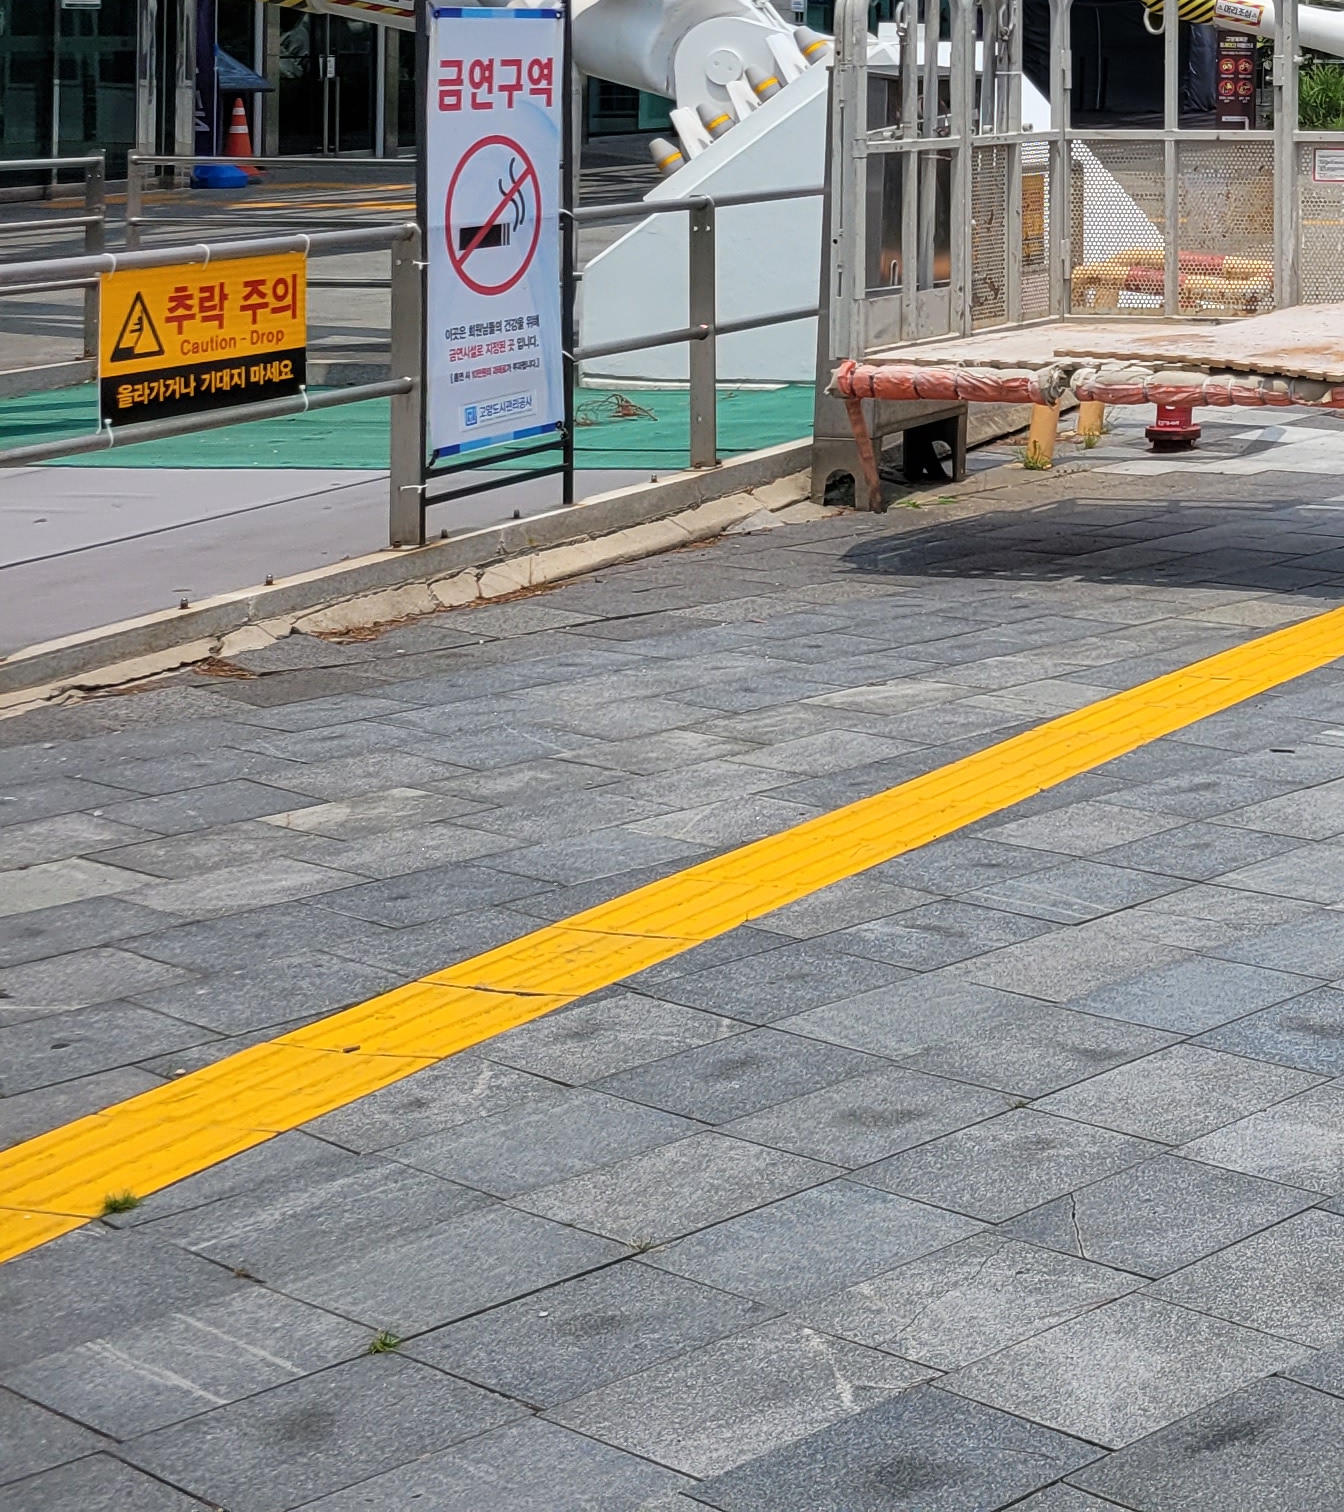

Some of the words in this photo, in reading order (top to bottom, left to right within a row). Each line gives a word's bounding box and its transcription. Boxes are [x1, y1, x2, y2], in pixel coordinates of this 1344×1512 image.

[1223, 4, 1252, 19] 머리조심
[437, 56, 555, 113] 금연구역
[164, 281, 229, 335] 추락
[239, 273, 298, 325] 주의
[445, 325, 467, 342] 이곳은
[504, 316, 525, 333] 건강을
[180, 335, 237, 356] Caution
[250, 329, 285, 347] Drop
[448, 344, 485, 363] 금연시설로
[486, 339, 506, 355] 지정된
[116, 373, 197, 409] 올라가거나
[200, 365, 246, 393] 기대지
[250, 359, 295, 386] 마세요
[479, 395, 533, 419] 고양도시관리공사
